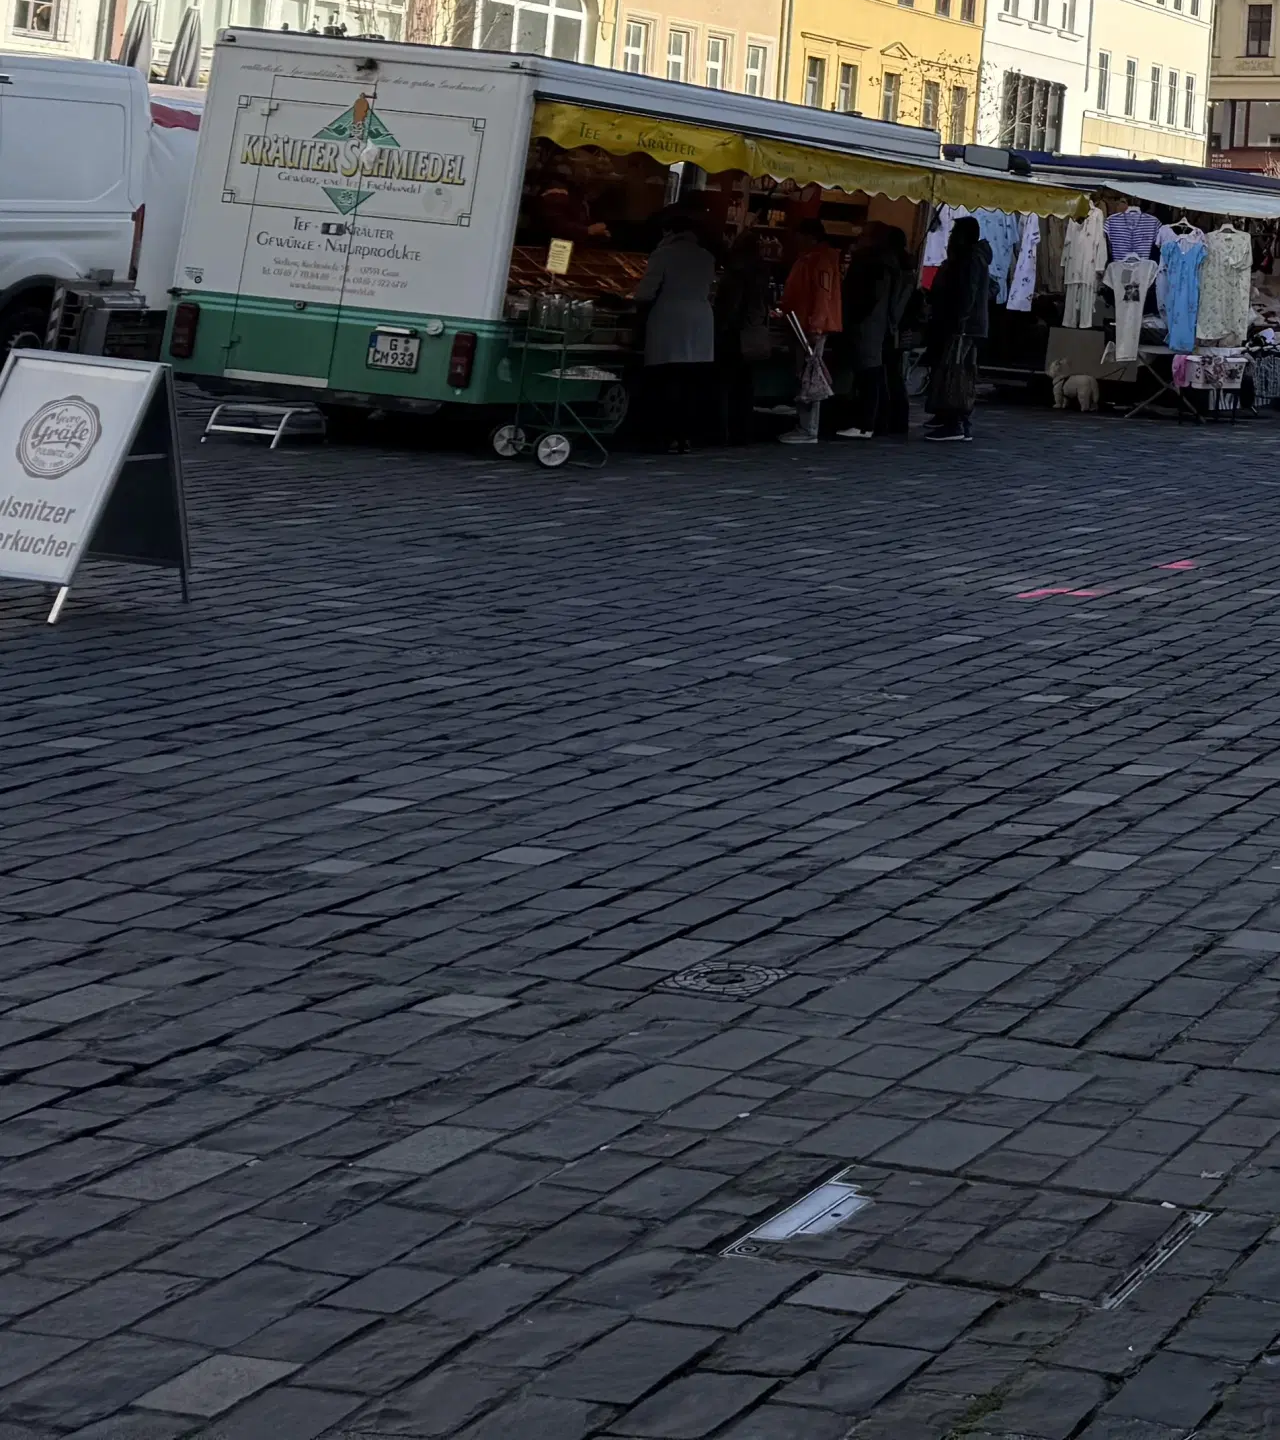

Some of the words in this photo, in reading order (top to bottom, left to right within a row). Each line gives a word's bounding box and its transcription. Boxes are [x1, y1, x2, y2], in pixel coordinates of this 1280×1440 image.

[240, 133, 339, 173] KRÄUTER
[389, 338, 399, 351] G
[390, 351, 414, 367] 933
[30, 412, 90, 449] Gräfe
